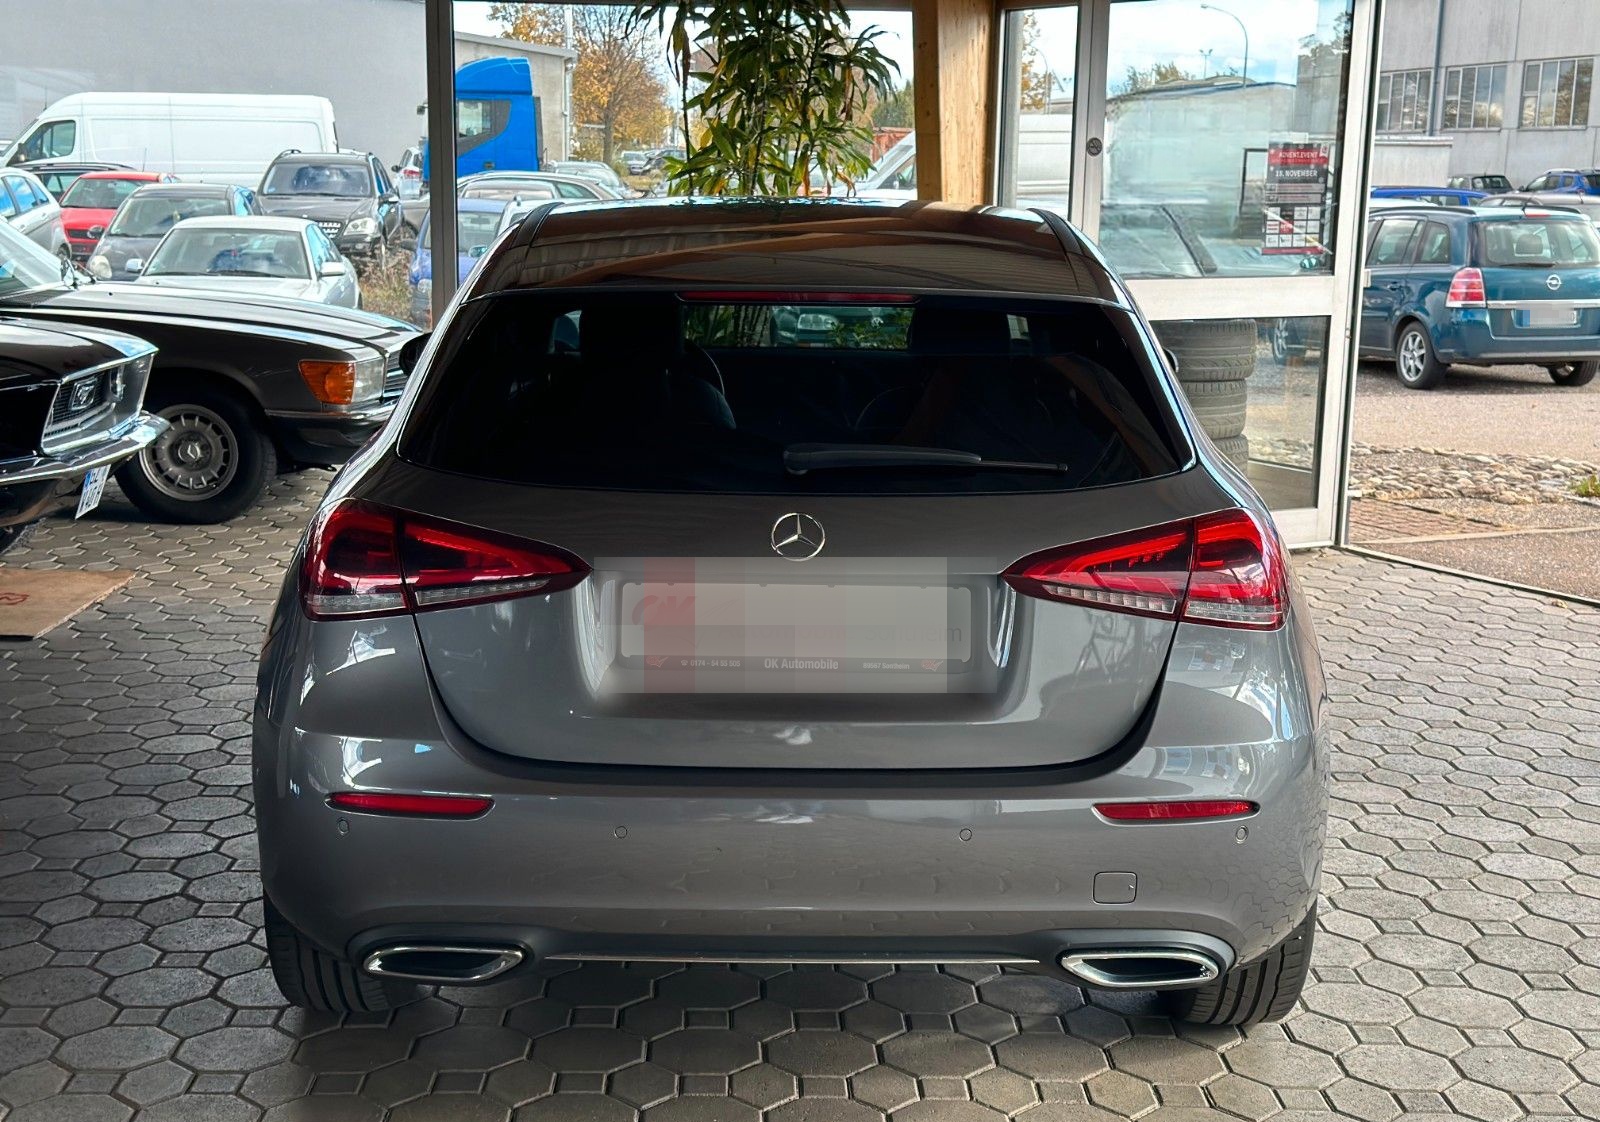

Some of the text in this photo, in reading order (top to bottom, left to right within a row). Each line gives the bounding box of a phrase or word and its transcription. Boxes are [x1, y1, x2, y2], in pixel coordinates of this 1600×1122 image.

[1285, 169, 1318, 177] NOVEMBER
[690, 659, 706, 668] 0174
[764, 658, 839, 670] OK Automobile
[881, 662, 910, 670] Sontheim
